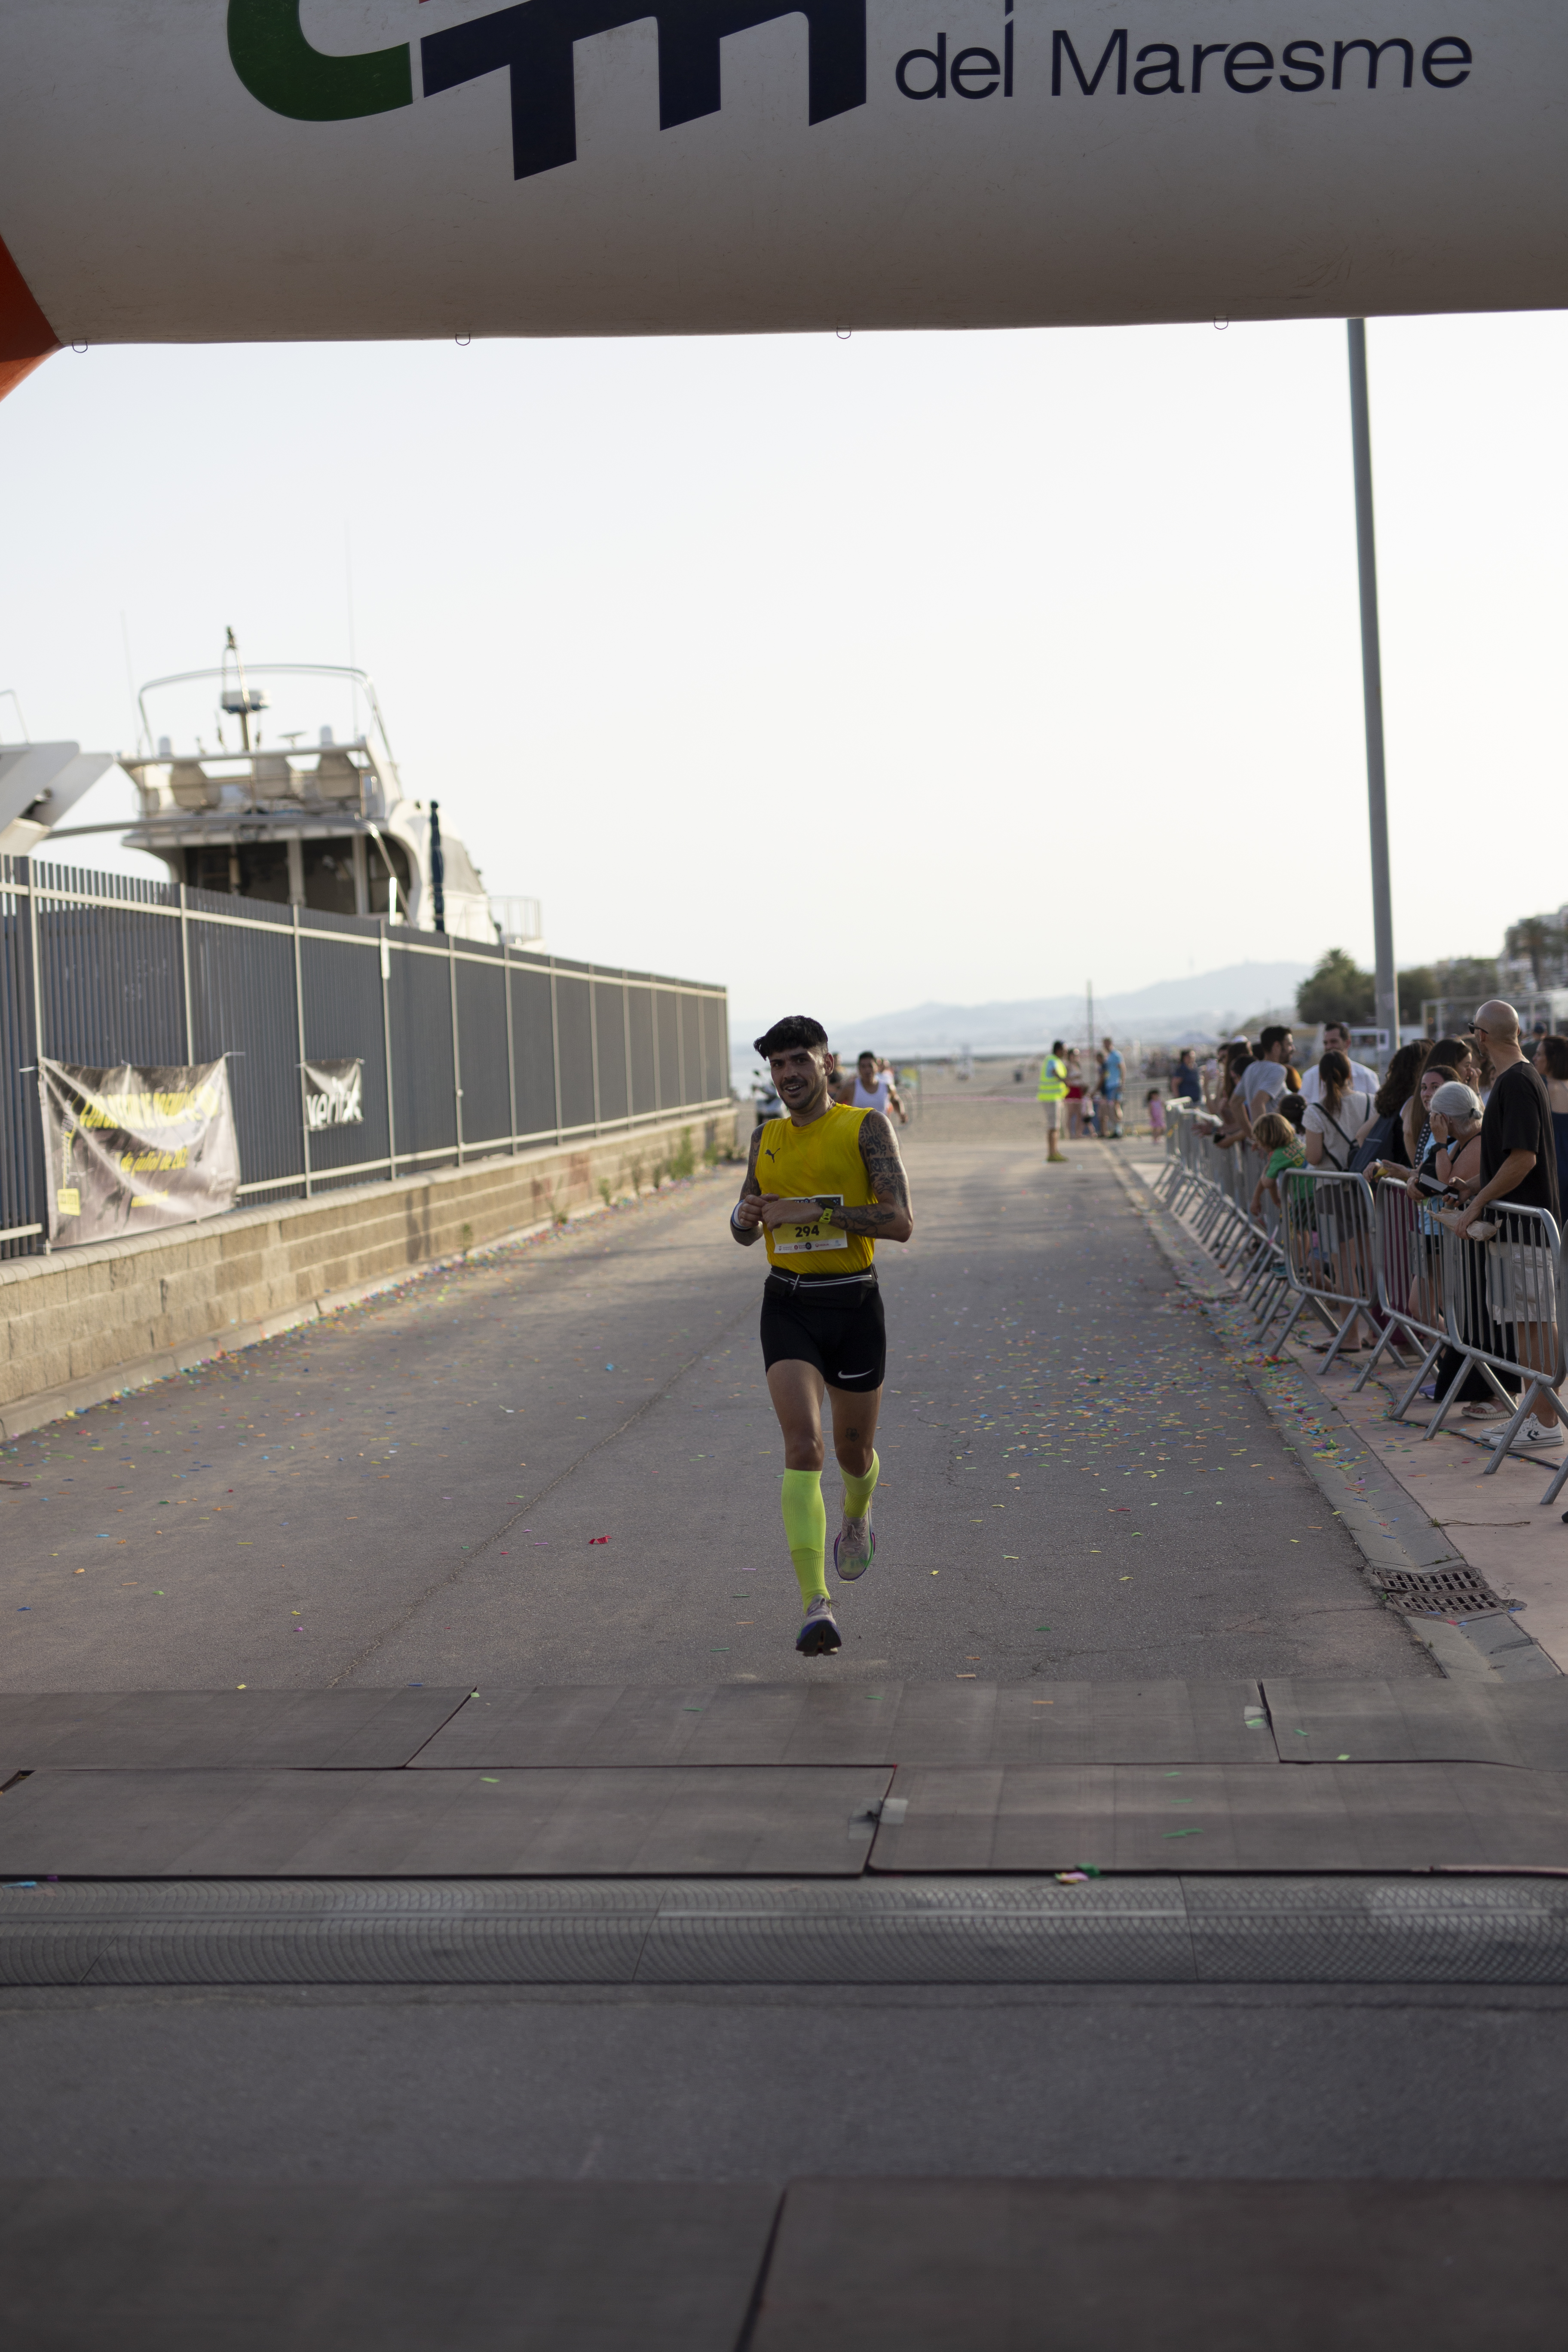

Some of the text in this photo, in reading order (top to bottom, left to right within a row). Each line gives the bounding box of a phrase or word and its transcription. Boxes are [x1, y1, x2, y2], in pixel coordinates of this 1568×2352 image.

[895, 19, 1472, 100] del Maresme
[795, 1225, 820, 1237] 294
